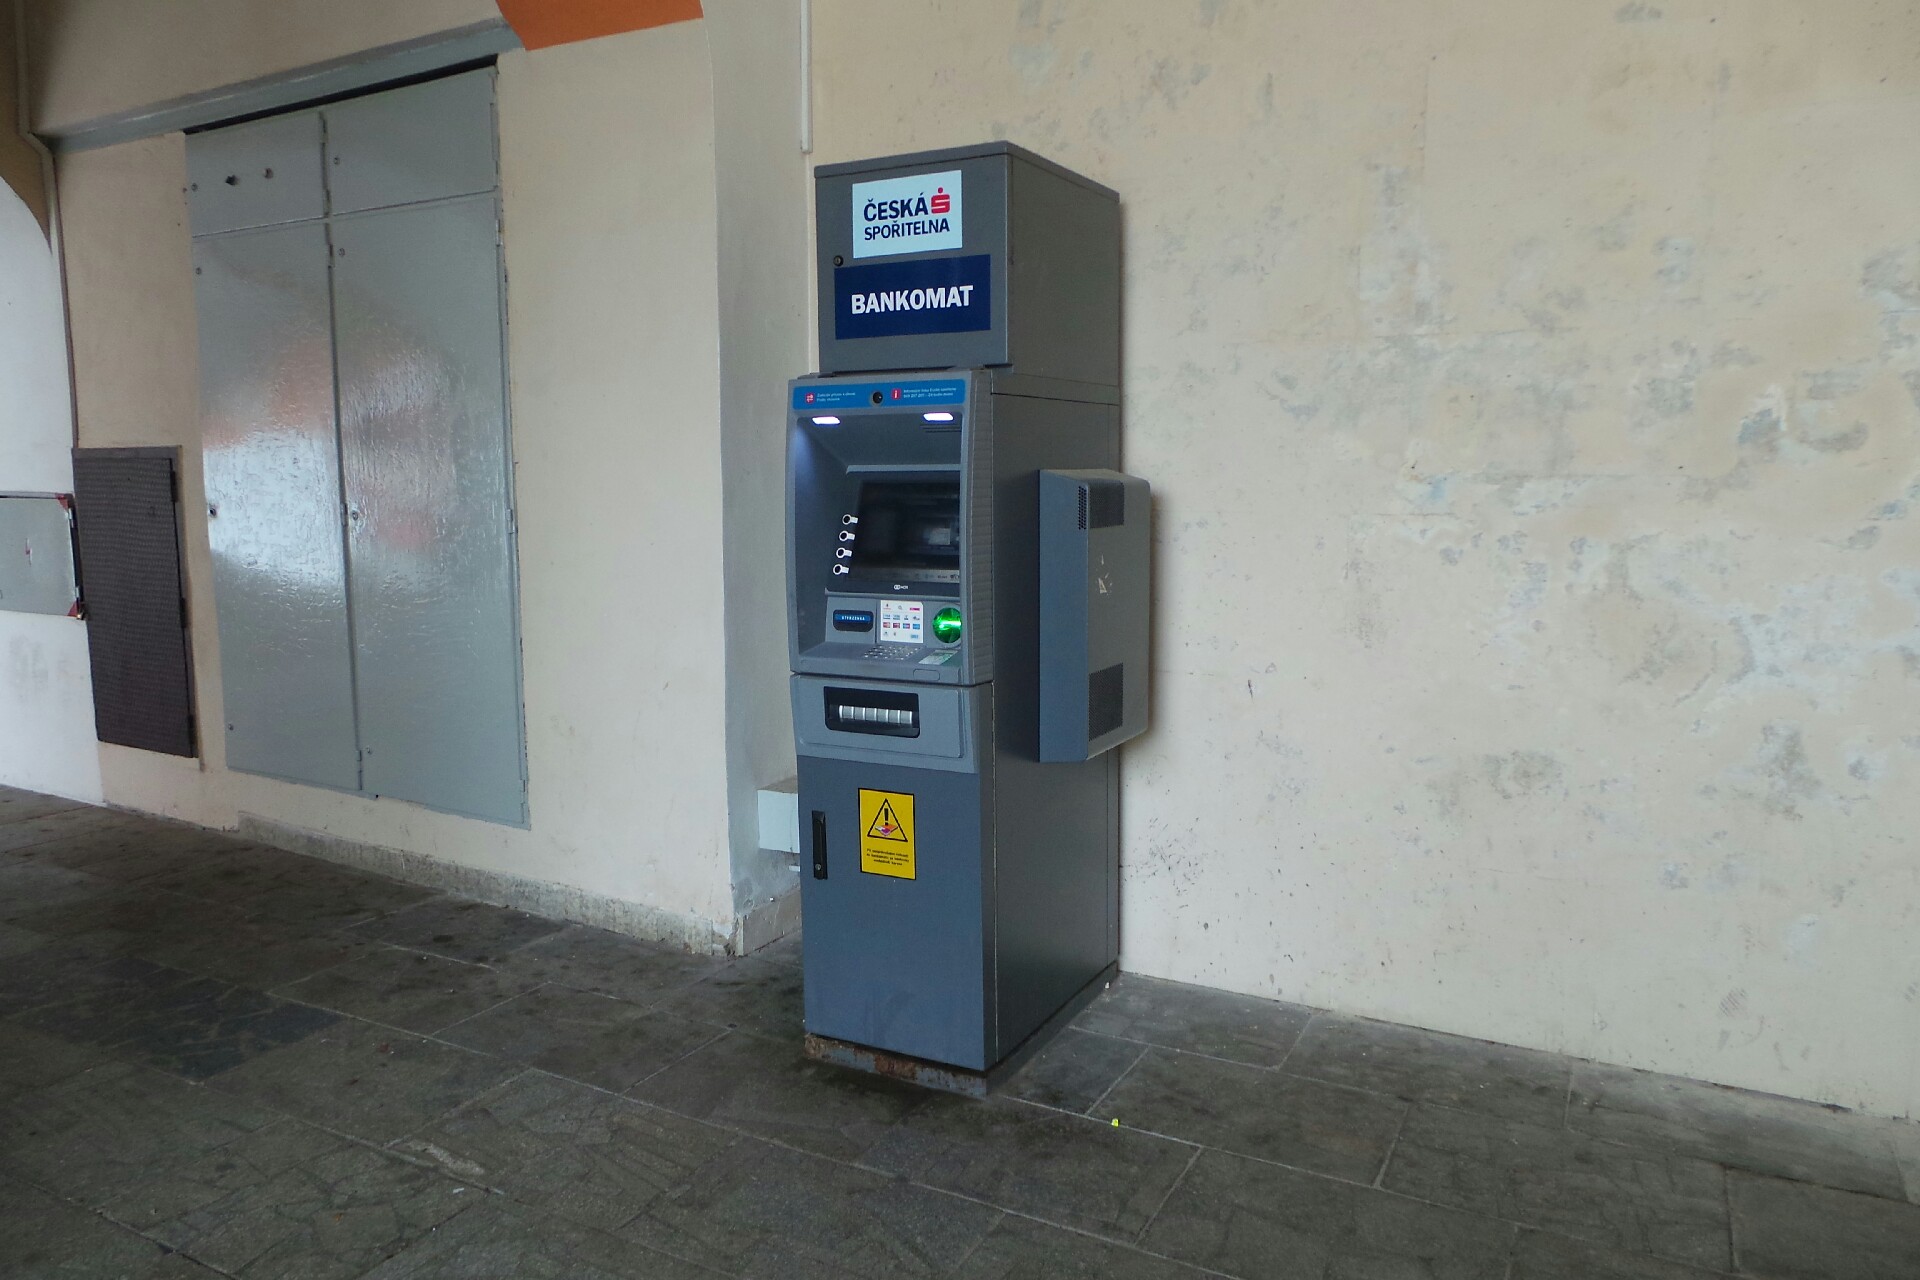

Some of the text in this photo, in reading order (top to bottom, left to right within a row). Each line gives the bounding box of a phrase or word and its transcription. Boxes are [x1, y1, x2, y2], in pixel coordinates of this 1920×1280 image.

[863, 192, 929, 222] ČESKÁ
[864, 218, 950, 241] SPOŘITELNA
[851, 285, 974, 315] BANKOMAT
